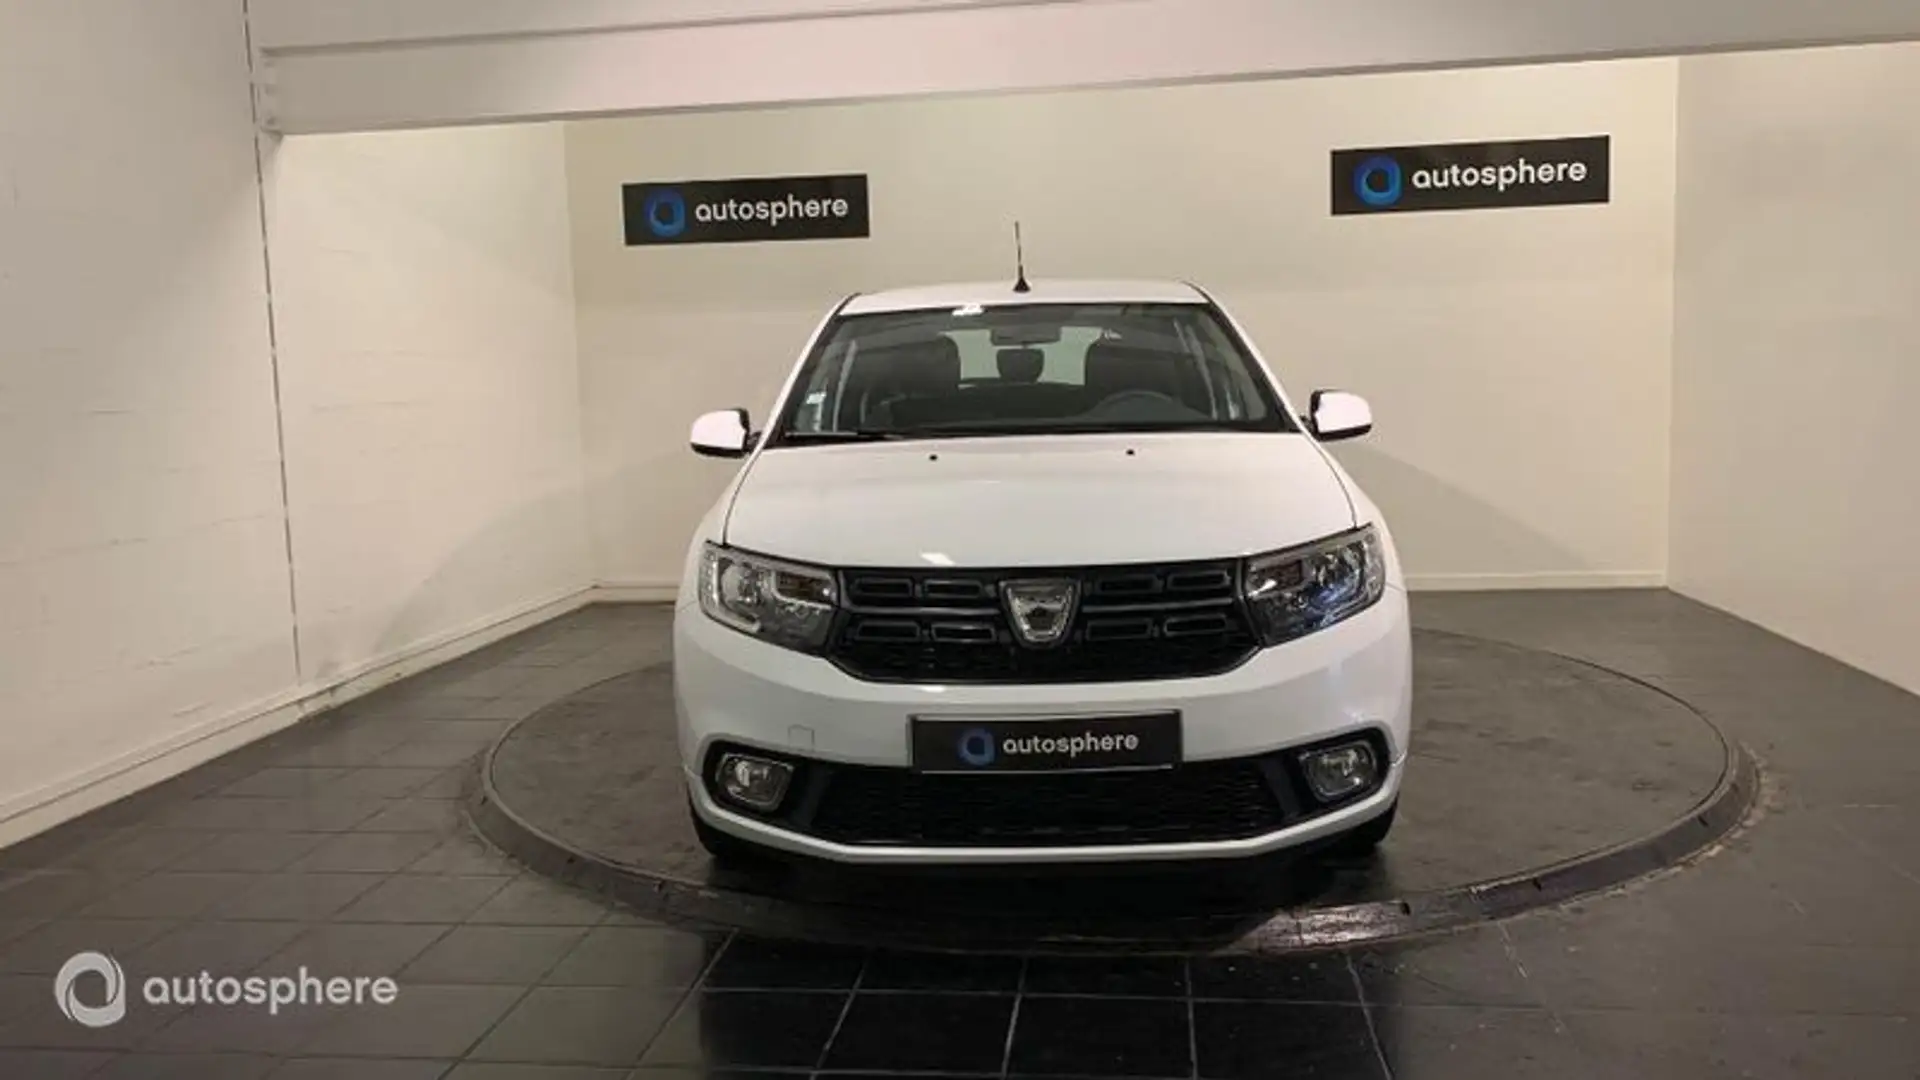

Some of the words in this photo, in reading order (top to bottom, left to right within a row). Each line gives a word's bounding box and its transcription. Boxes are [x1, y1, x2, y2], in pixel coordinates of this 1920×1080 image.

[1412, 158, 1587, 191] autosphere
[695, 194, 848, 226] autosphere
[1003, 731, 1139, 757] autosphere
